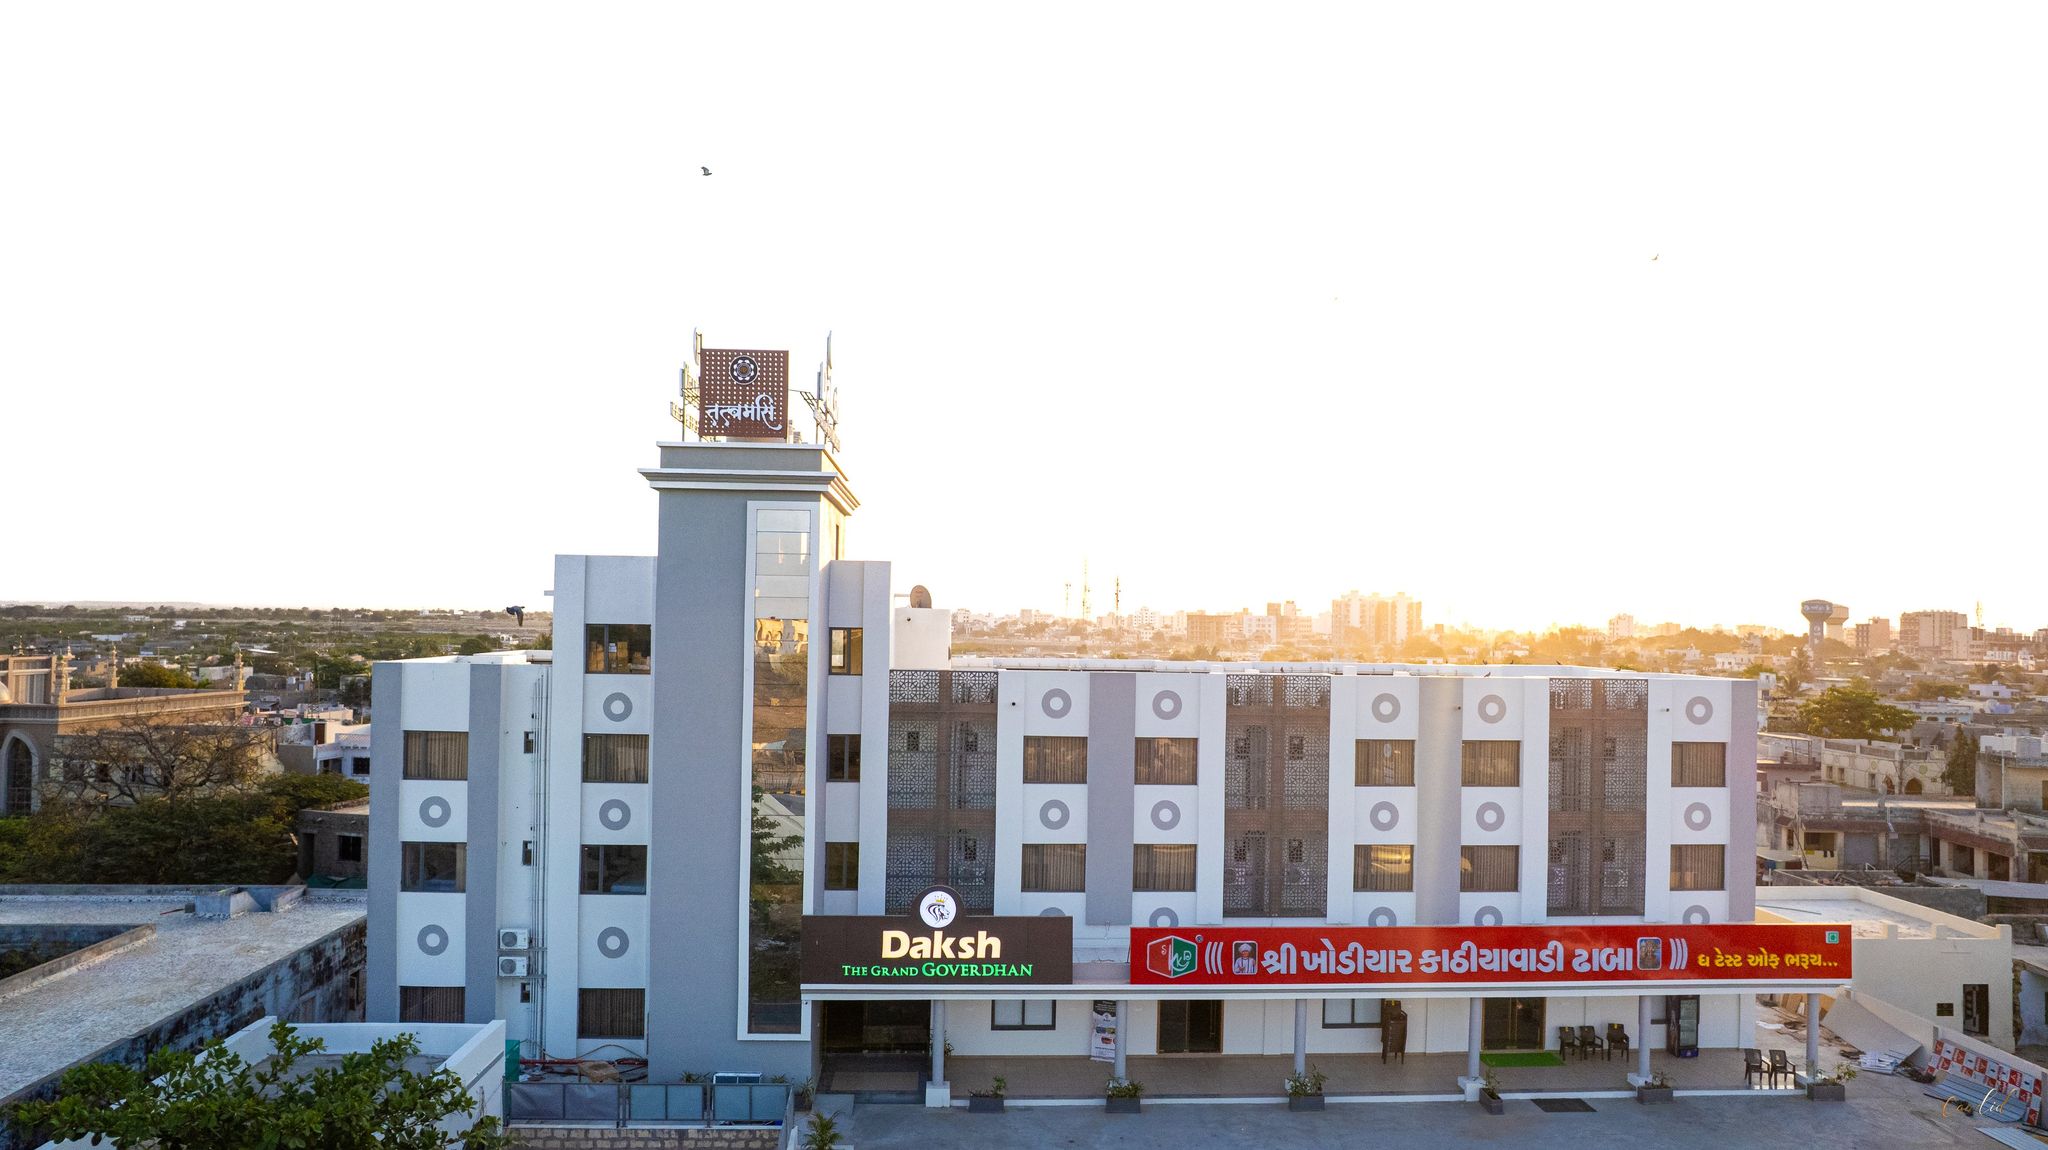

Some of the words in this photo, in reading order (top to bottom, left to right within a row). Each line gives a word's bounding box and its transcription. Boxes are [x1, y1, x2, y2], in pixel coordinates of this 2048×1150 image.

[881, 930, 1001, 959] Daksh
[1261, 942, 1297, 975] શ્રી
[1301, 938, 1413, 975] ખોડીયાર
[1418, 940, 1564, 974] કાઠીયાવાડી
[1571, 947, 1633, 972] ઢાબા
[842, 965, 868, 977] THE
[871, 965, 918, 977] GRAND
[921, 962, 1033, 977] GOVERDHAN
[1714, 947, 1743, 967] ટેસ્ટ
[1747, 947, 1780, 969] ઓફ
